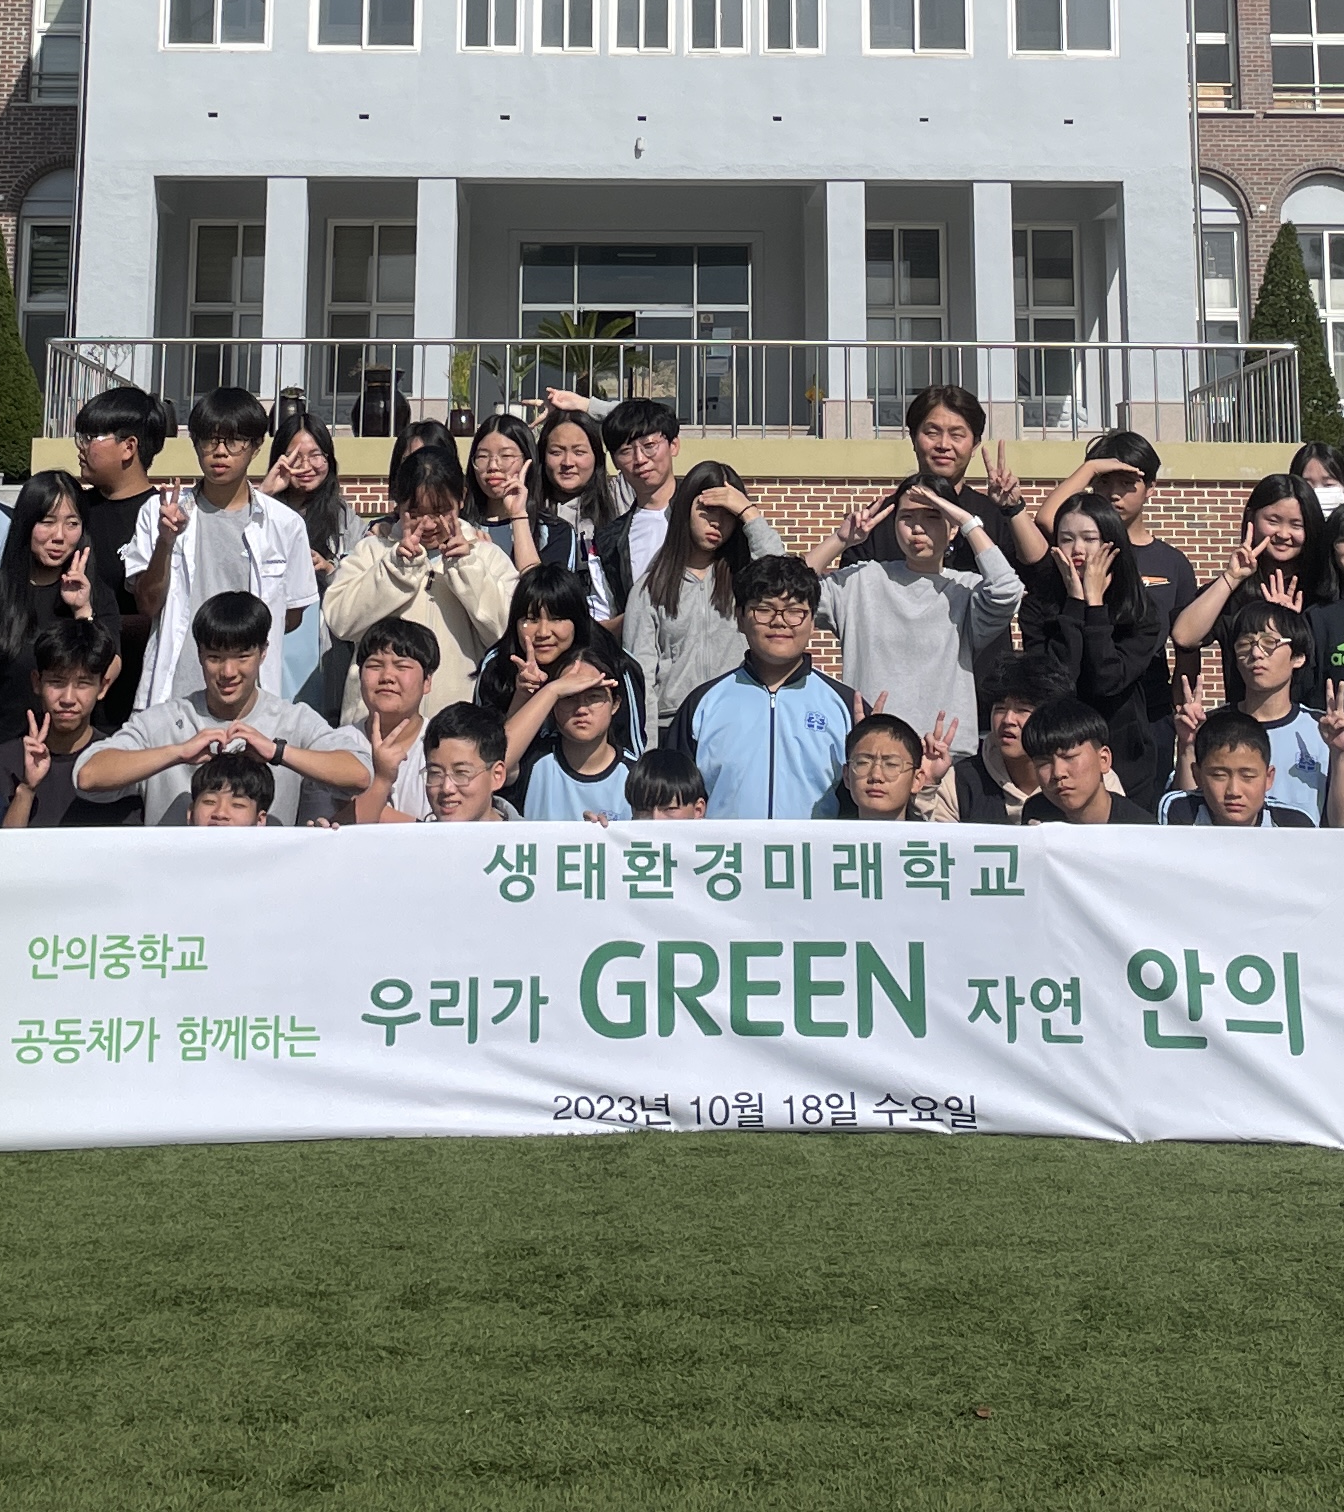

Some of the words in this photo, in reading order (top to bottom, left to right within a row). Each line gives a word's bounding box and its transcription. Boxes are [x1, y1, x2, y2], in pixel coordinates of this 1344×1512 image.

[484, 841, 1025, 902] 생태환경미래학교
[28, 934, 208, 979] 안의중학교
[12, 1017, 160, 1063] 공동체가
[177, 1015, 320, 1061] 함께하는
[361, 976, 549, 1046] 우리가
[580, 940, 927, 1039] GREEN
[968, 976, 1084, 1044] 자연
[1128, 948, 1304, 1056] 안의
[553, 1093, 673, 1128] 2023년
[689, 1091, 766, 1127] 10월
[781, 1091, 858, 1128] 18일
[871, 1092, 978, 1130] 수요일
